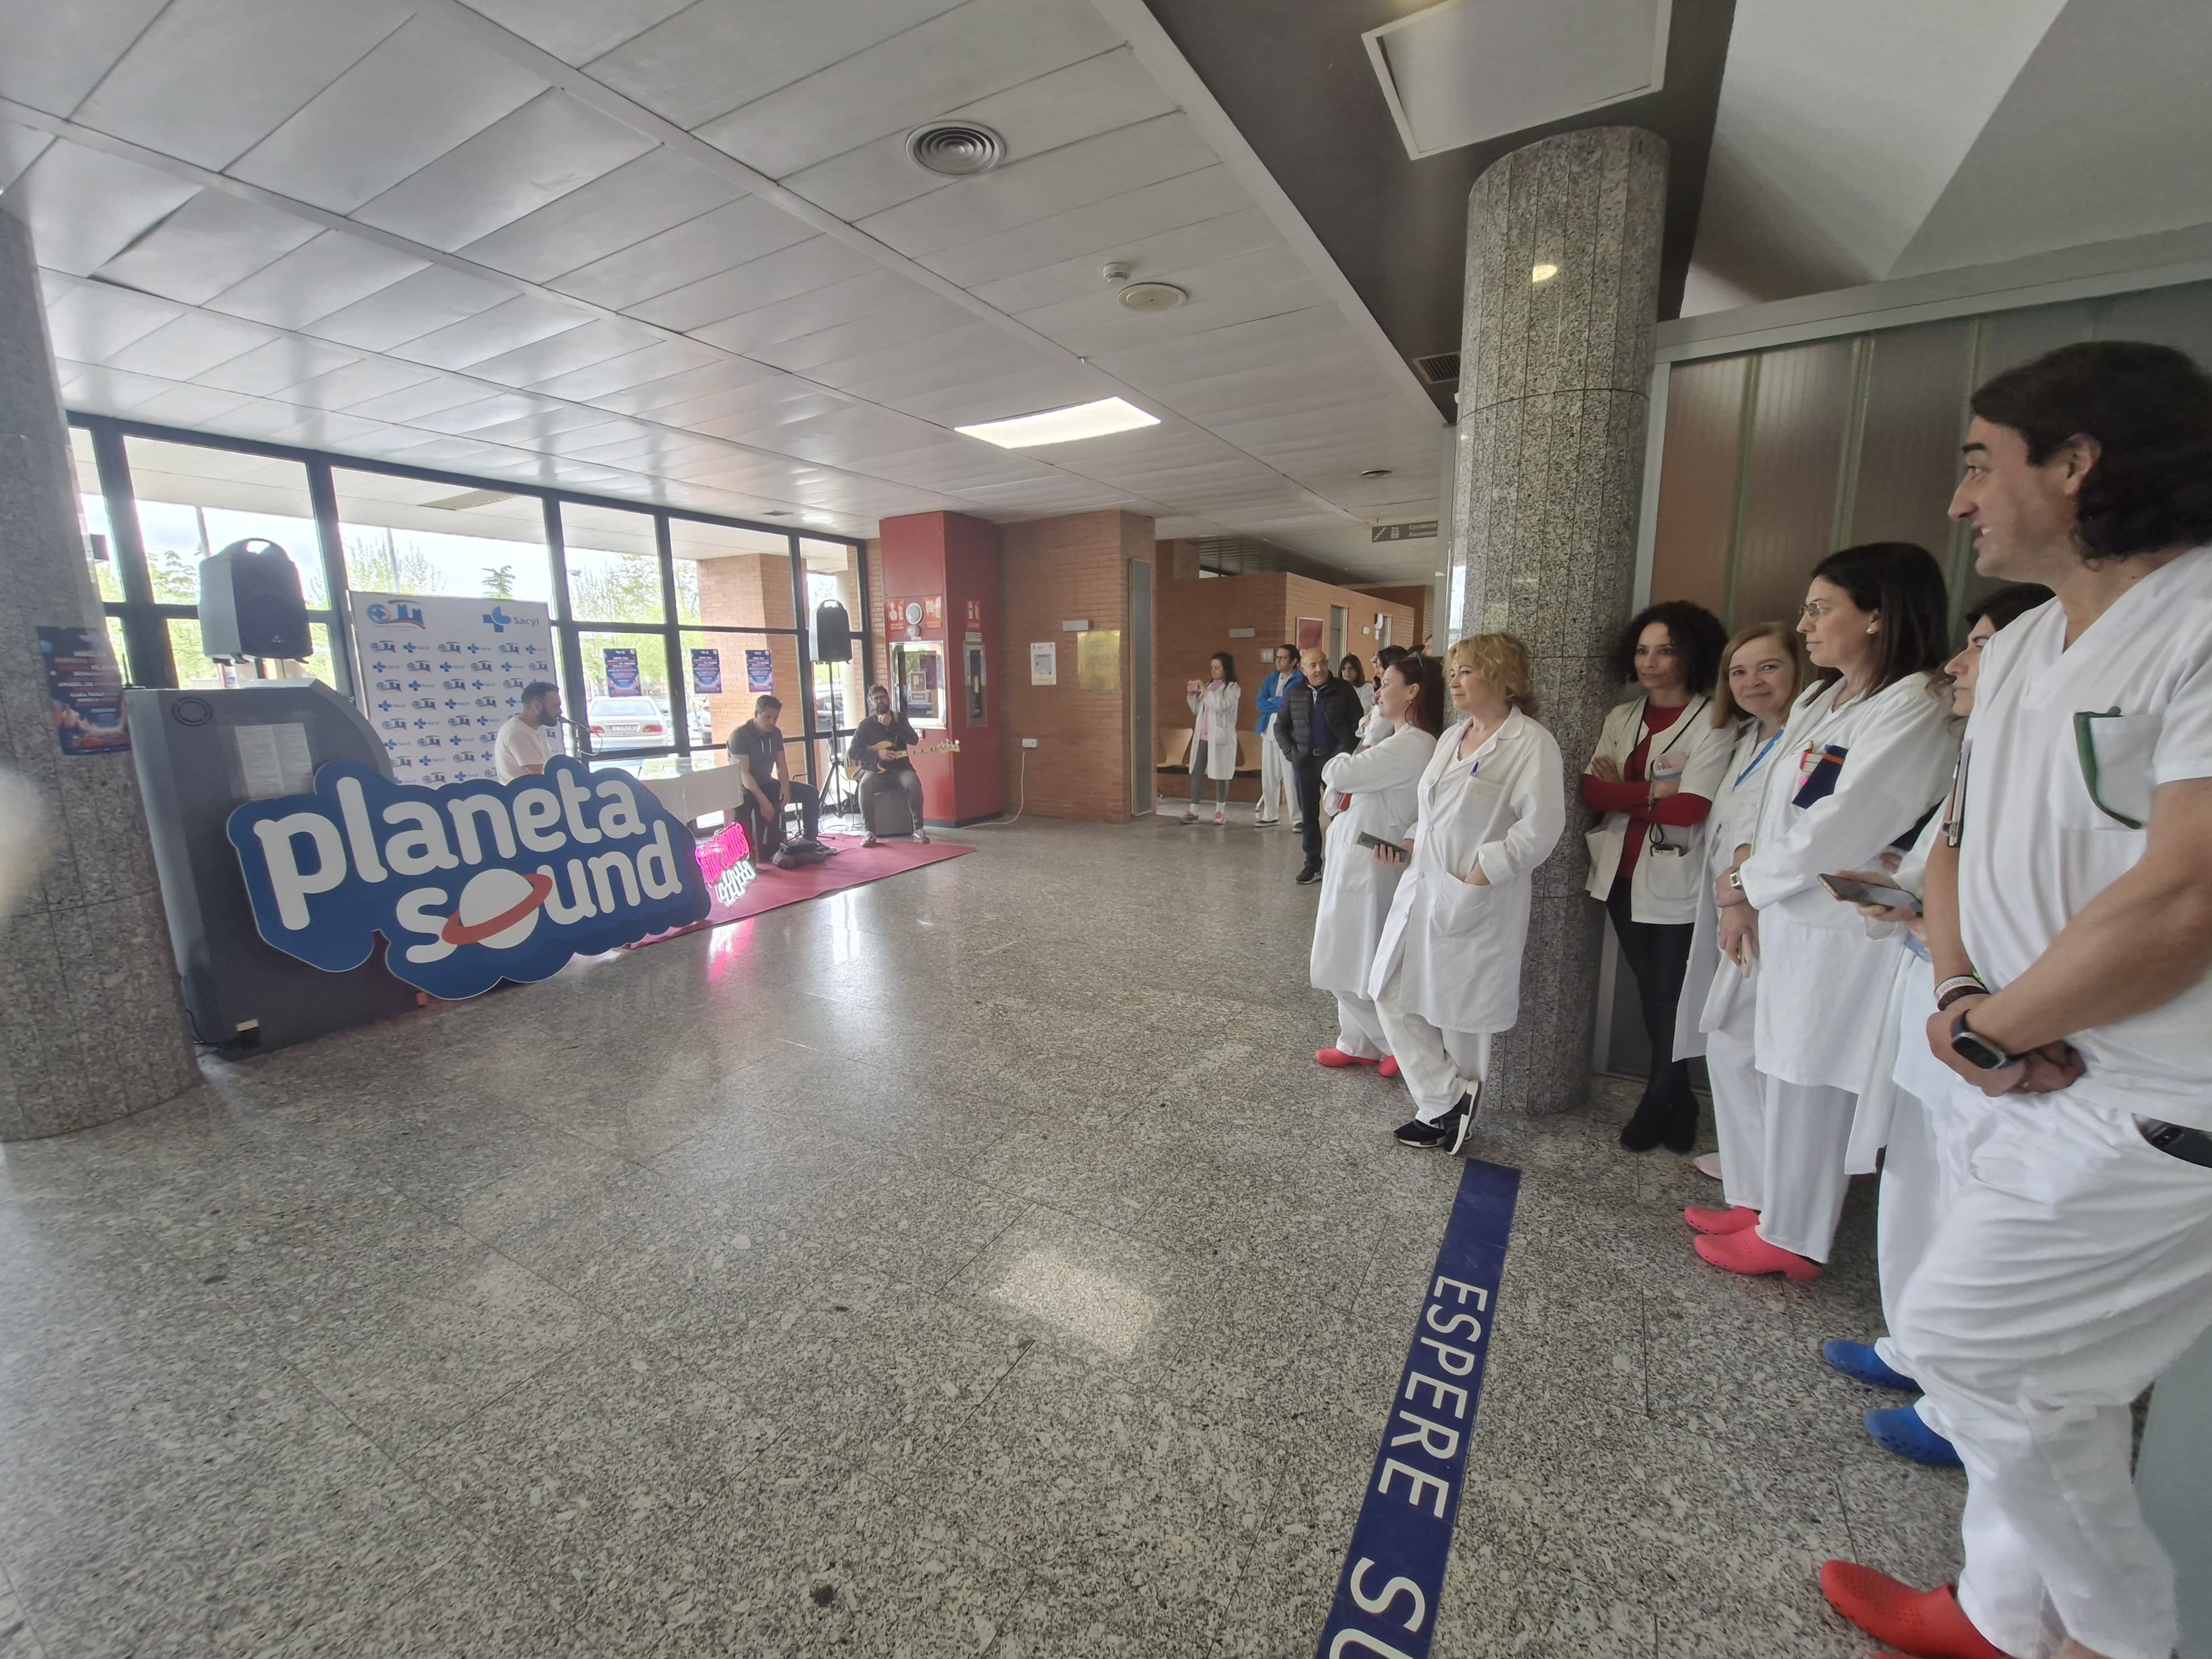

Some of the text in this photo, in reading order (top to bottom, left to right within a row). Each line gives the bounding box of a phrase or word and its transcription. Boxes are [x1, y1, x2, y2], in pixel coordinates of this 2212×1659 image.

[513, 616, 539, 627] Sacyl
[253, 768, 646, 930] planeta
[395, 820, 682, 964] sound
[1378, 1275, 1489, 1519] ESPERE
